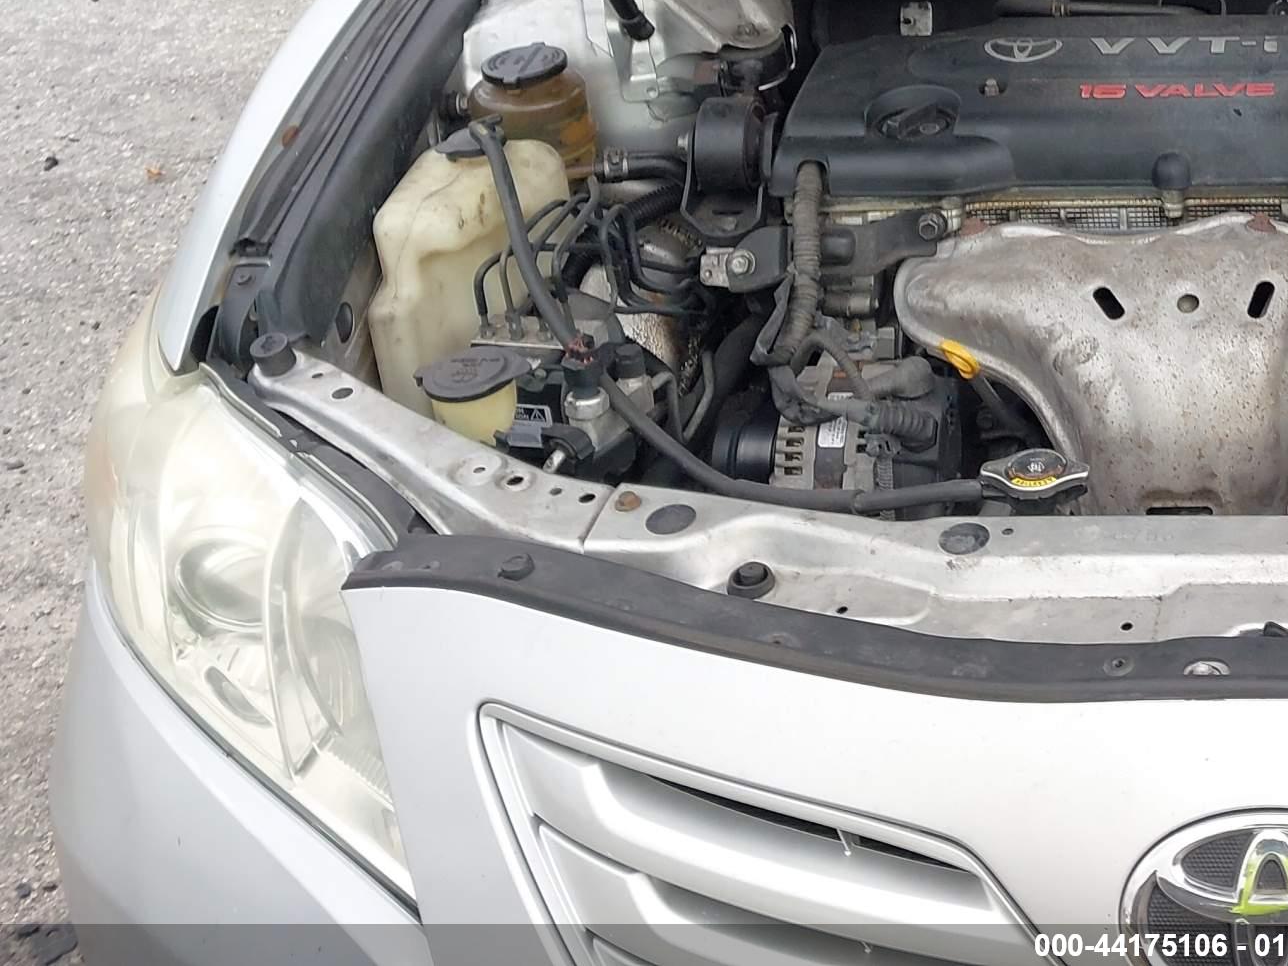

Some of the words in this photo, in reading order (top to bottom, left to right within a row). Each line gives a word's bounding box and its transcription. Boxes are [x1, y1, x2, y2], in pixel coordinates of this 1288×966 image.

[1090, 34, 1279, 55] VVT-i
[1079, 84, 1126, 100] 16
[1135, 82, 1277, 99] VALVE
